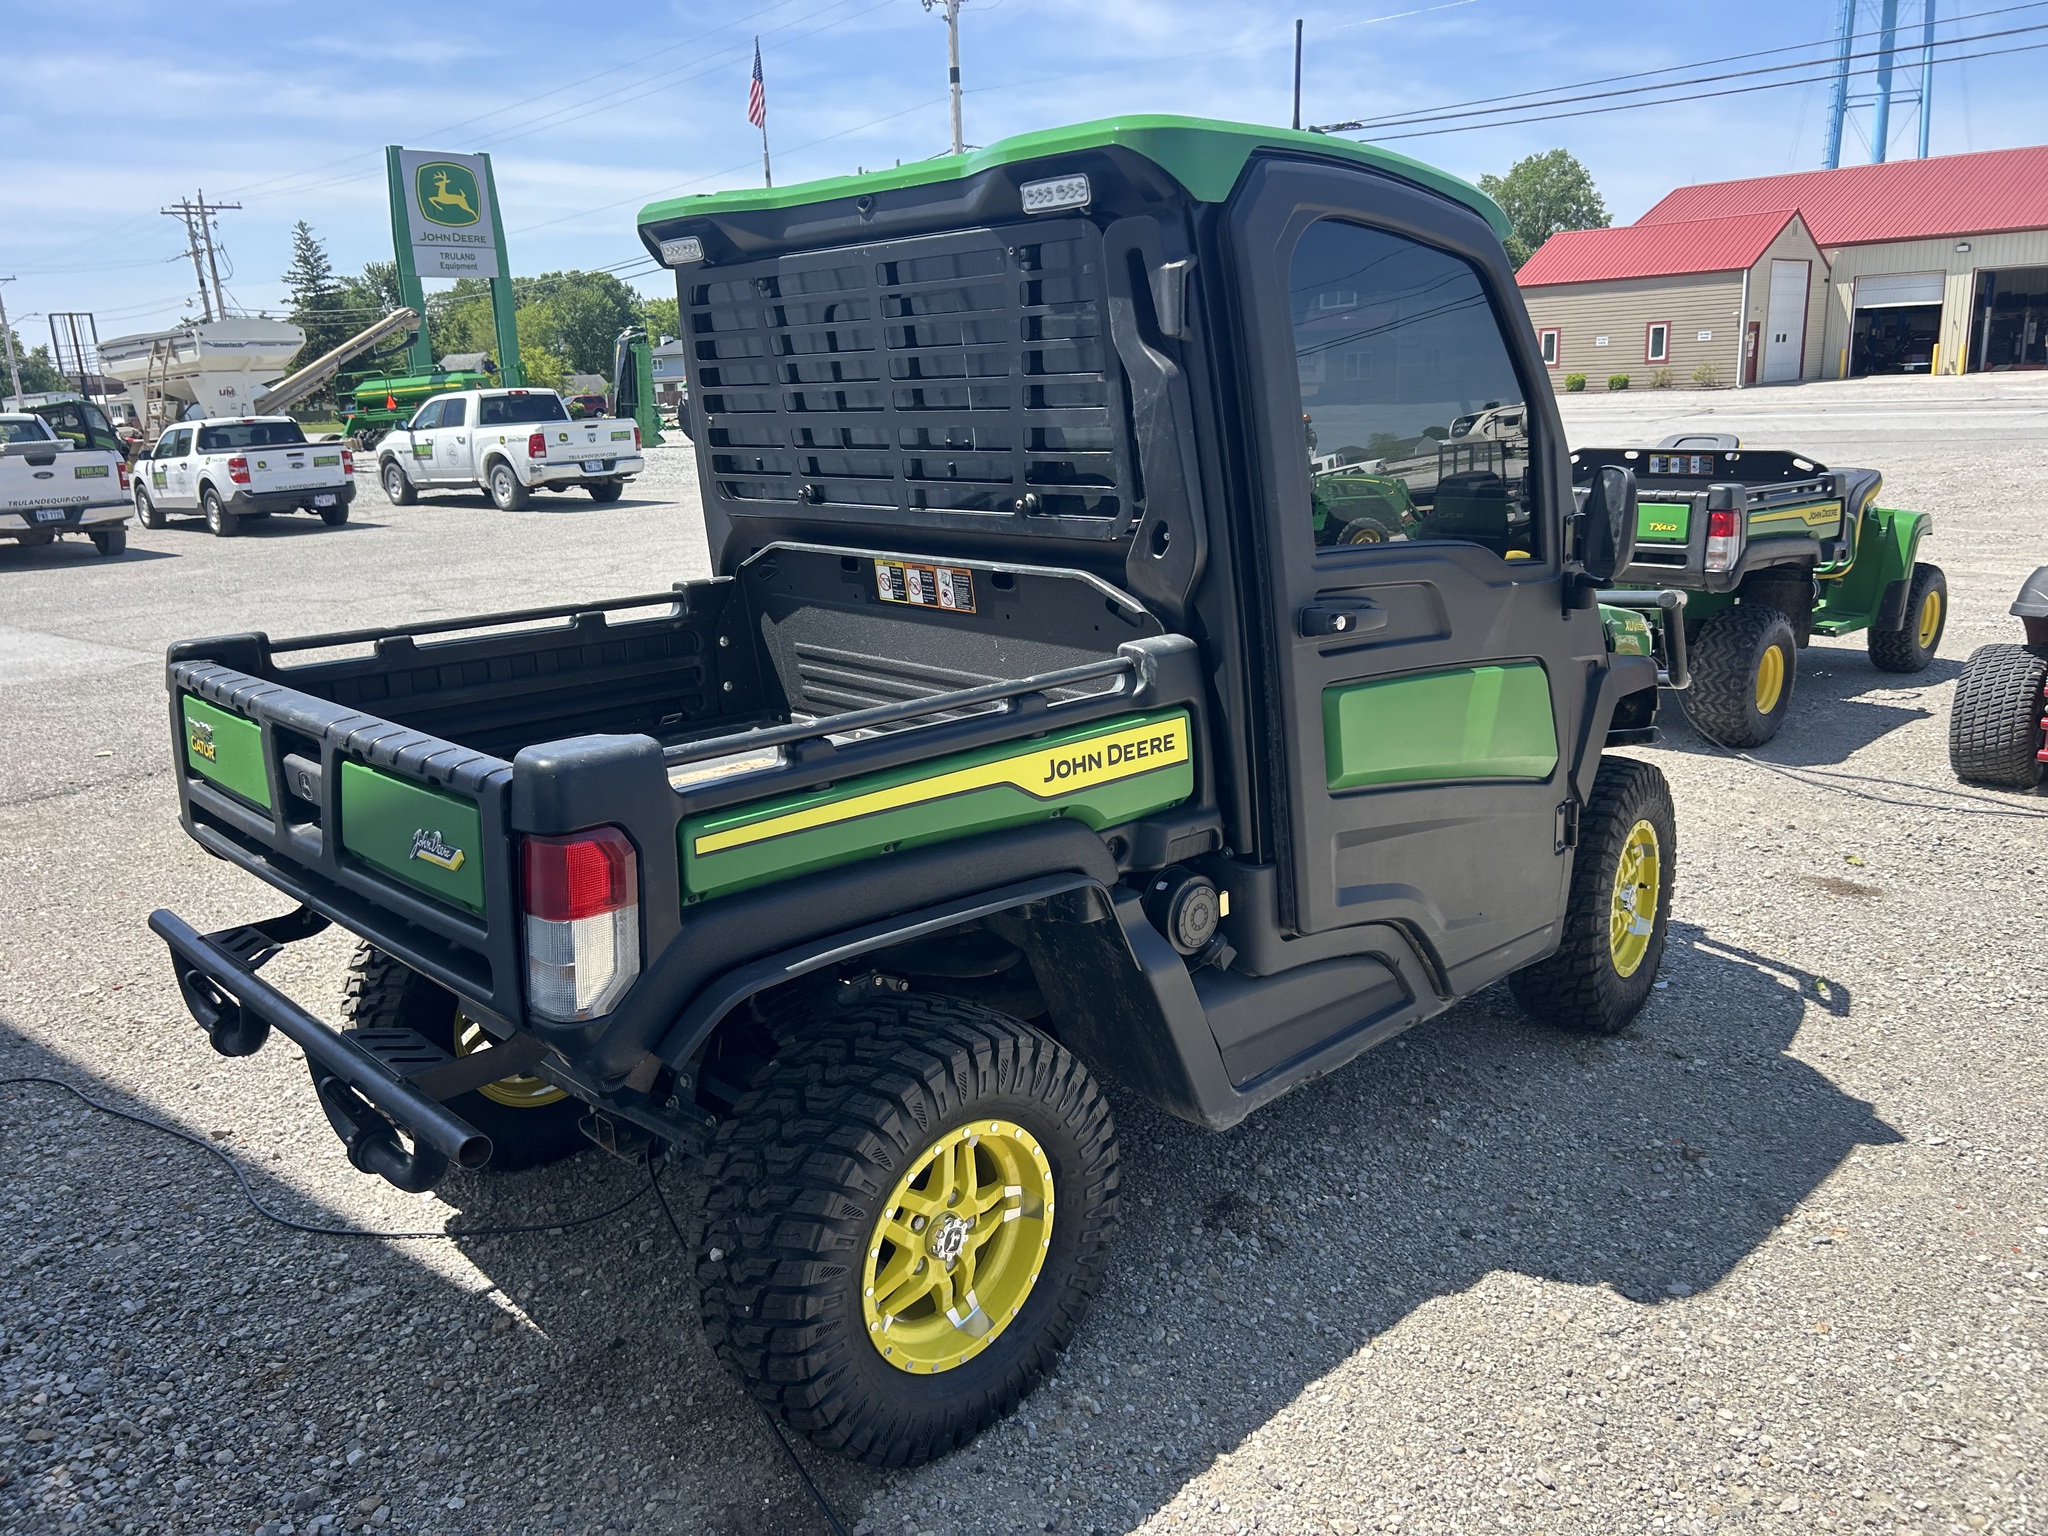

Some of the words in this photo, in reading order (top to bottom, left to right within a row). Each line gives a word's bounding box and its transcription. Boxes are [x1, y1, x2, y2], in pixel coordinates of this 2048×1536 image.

[420, 231, 451, 242] JOHN
[452, 232, 487, 243] DEERE
[440, 252, 476, 261] TRULAND
[440, 262, 478, 271] Equipment
[76, 466, 108, 475] TRULAND
[8, 495, 90, 507] TRULANDEQUIP.COM
[1808, 511, 1822, 520] JOHN
[1822, 508, 1838, 518] DEERE
[190, 735, 216, 761] GATOR
[1043, 751, 1102, 783] JOHN
[1107, 732, 1175, 766] DEERE
